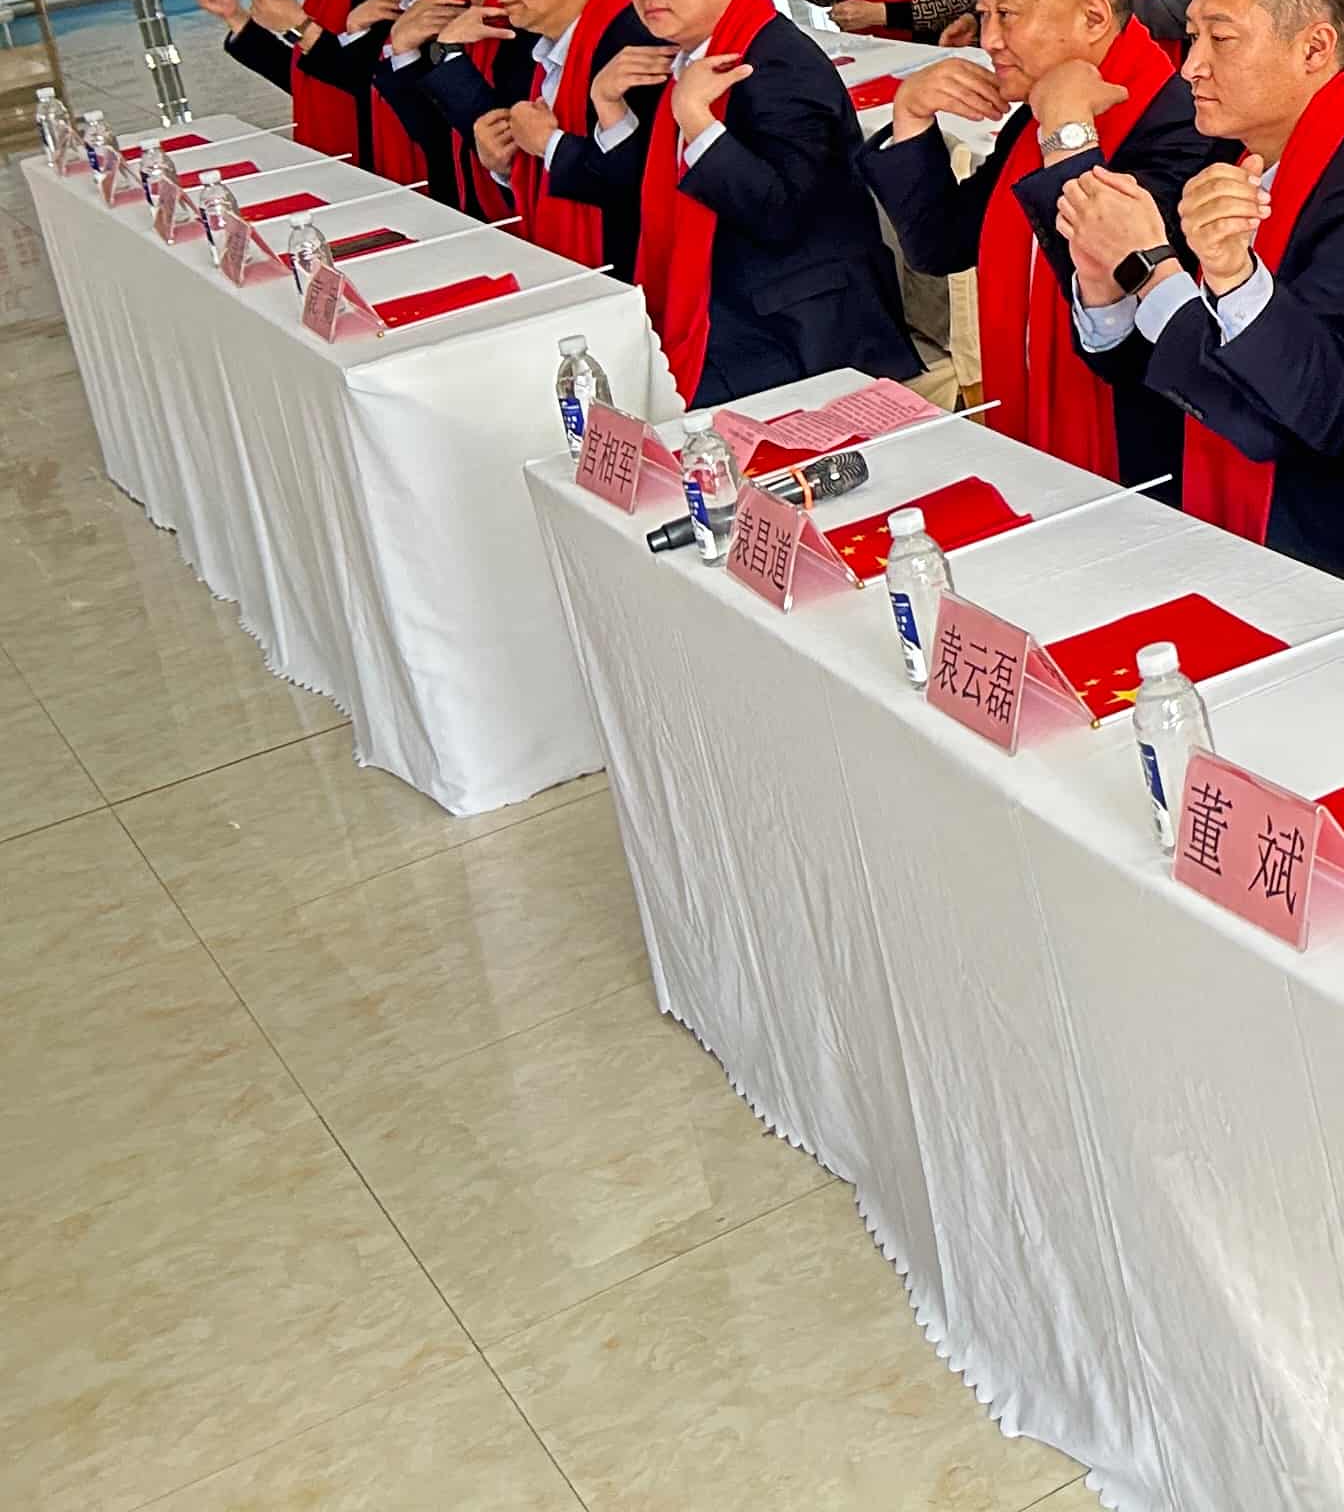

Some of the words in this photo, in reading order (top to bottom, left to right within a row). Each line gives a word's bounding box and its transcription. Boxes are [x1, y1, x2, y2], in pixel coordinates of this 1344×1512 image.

[732, 507, 791, 590] 袁昌道
[934, 624, 1018, 724] 袁云磊
[1183, 785, 1304, 916] 董斌
